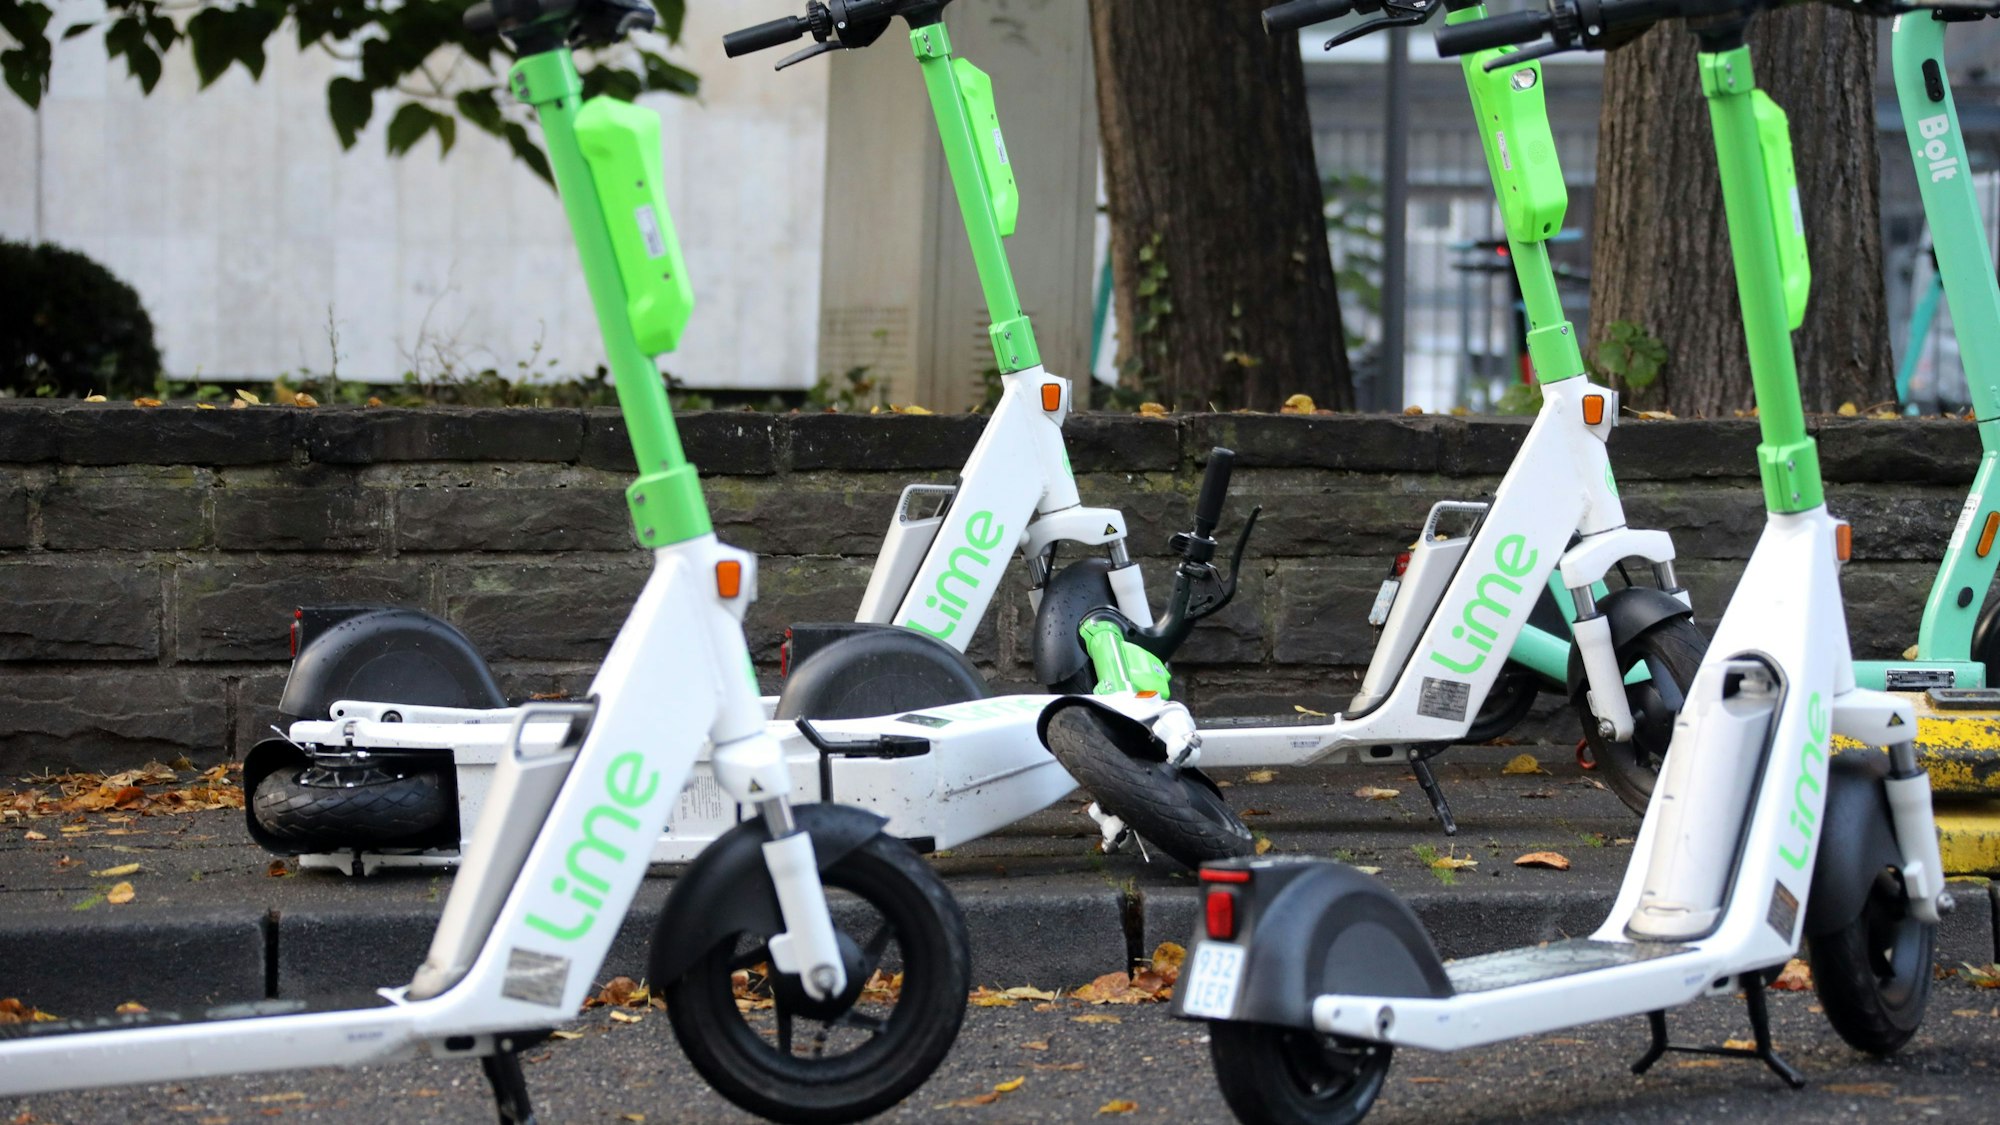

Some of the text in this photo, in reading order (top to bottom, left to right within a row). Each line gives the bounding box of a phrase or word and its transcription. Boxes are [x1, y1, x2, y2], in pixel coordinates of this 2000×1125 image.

[1917, 113, 1959, 183] Bolt
[907, 512, 1003, 640] Lime
[1431, 535, 1537, 673] Lime
[526, 753, 658, 939] Lime
[1780, 693, 1824, 869] Lime
[1199, 950, 1236, 978] 932
